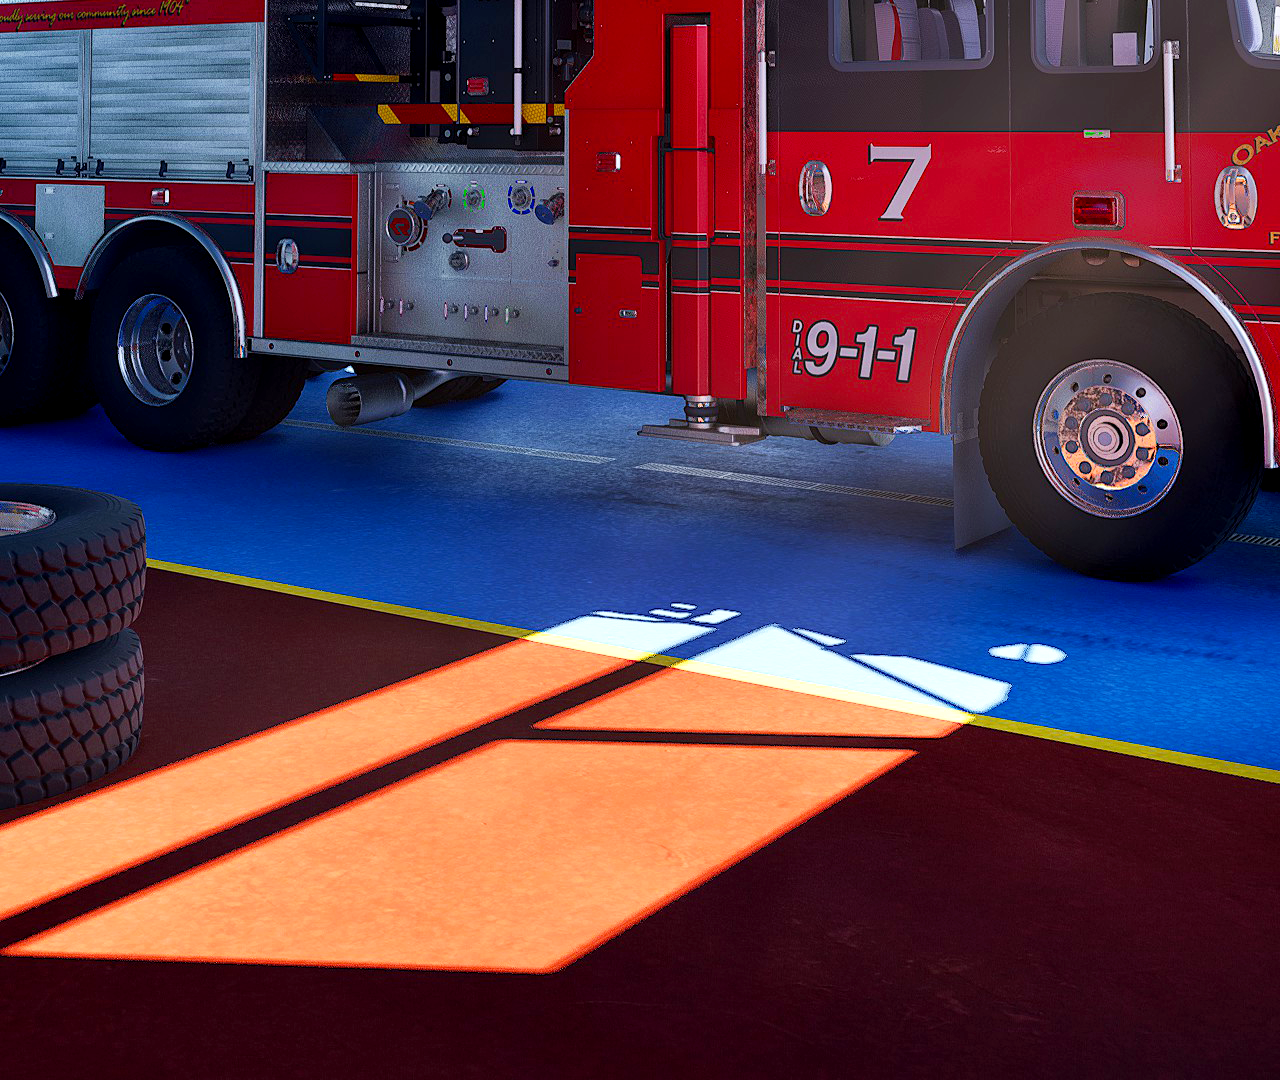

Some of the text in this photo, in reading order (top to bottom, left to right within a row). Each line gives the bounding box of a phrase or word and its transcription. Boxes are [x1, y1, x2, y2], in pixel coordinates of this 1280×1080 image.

[25, 9, 57, 29] serving
[76, 4, 131, 28] community
[131, 6, 157, 19] since
[868, 142, 933, 222] 7
[791, 318, 804, 375] DIAL
[803, 319, 918, 384] 9-1-1
